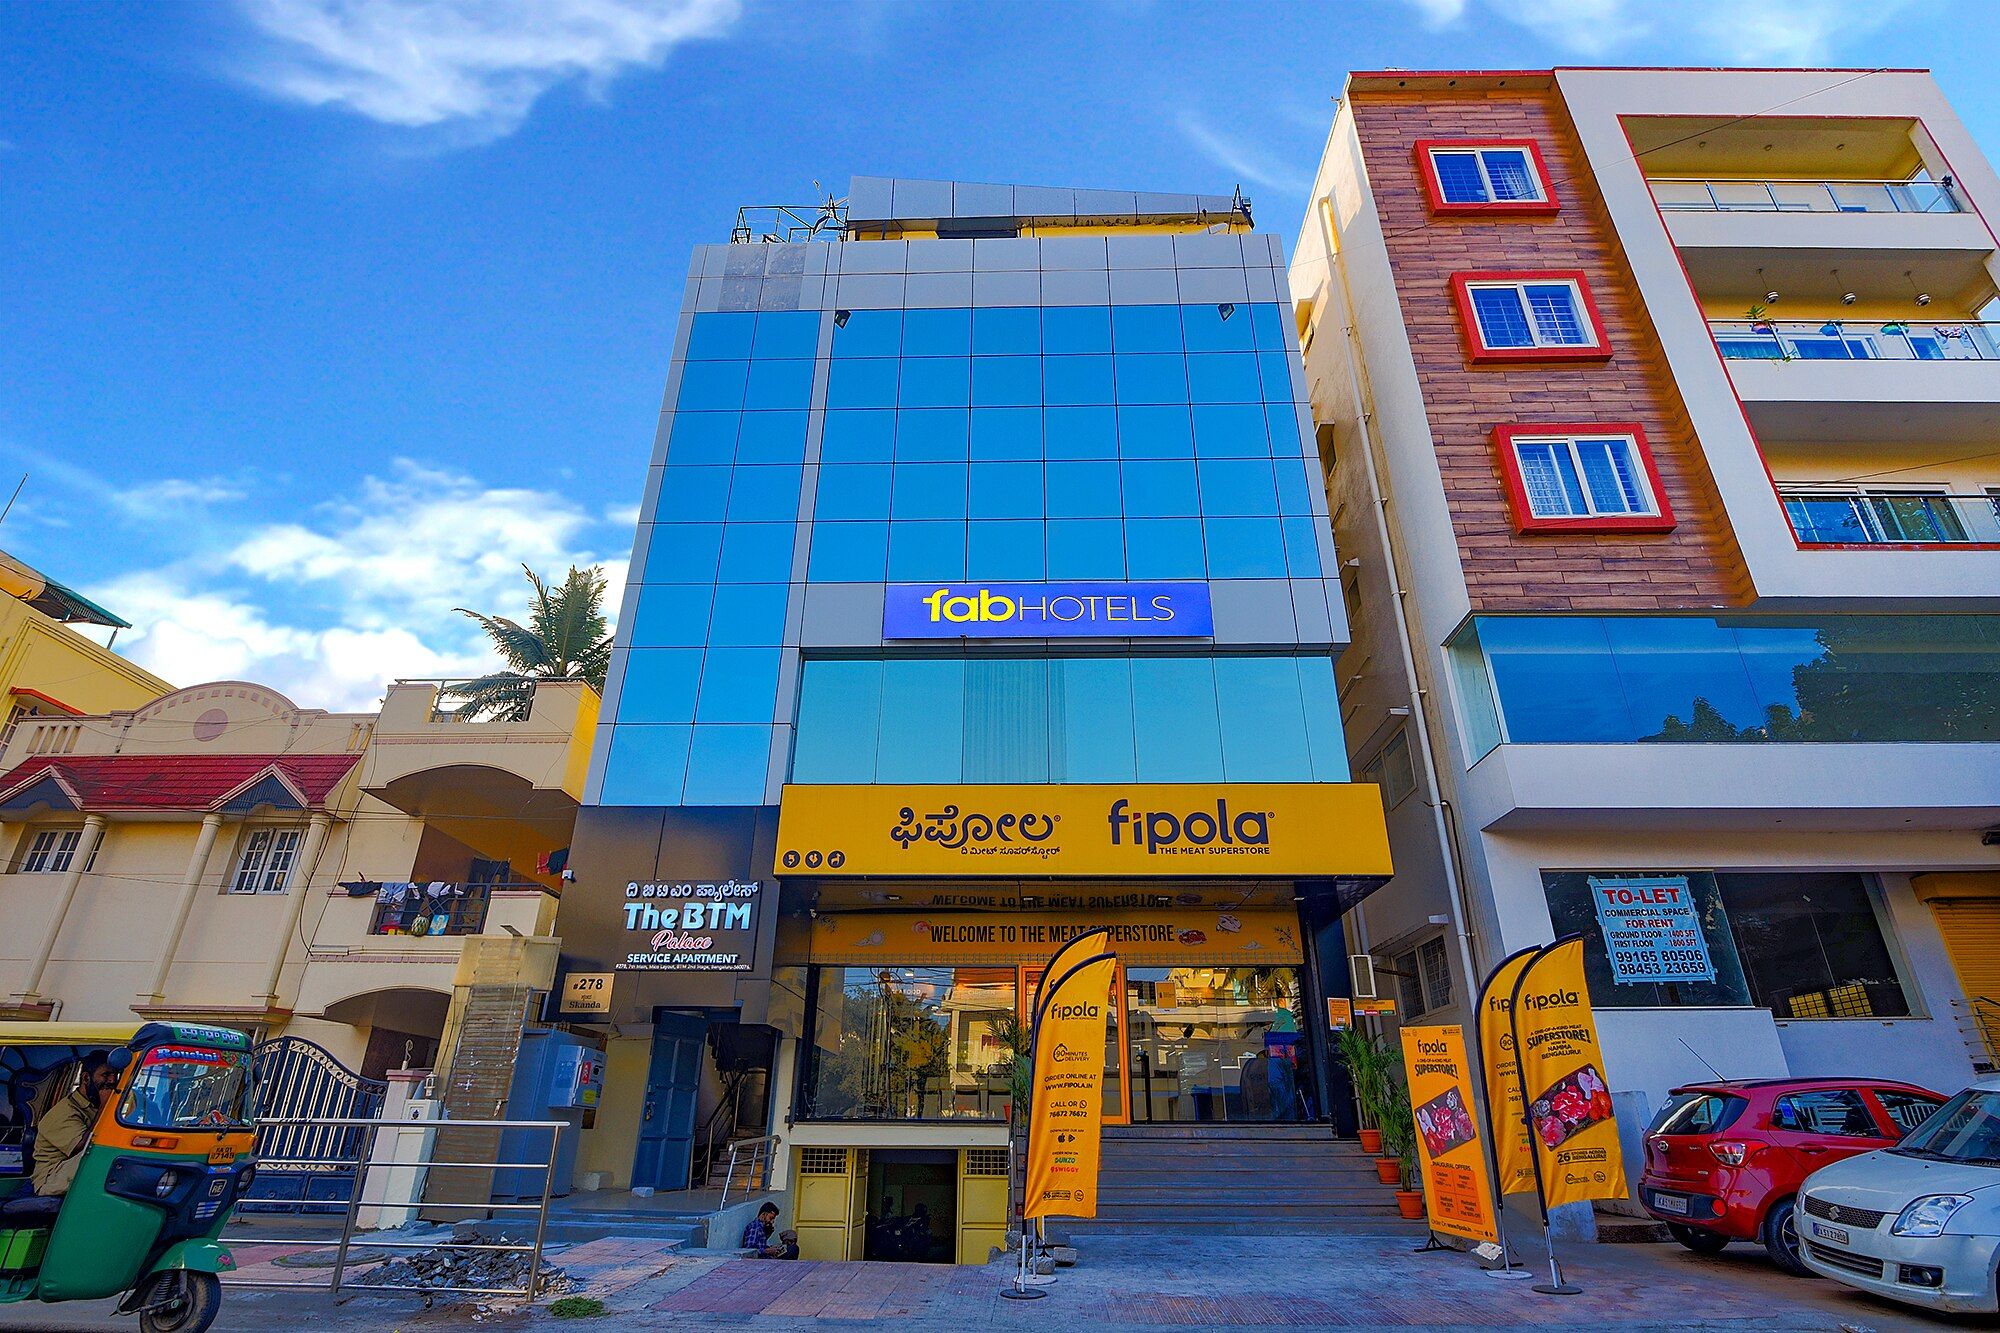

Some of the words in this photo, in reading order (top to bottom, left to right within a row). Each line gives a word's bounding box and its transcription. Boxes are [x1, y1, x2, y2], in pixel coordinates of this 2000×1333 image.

[1108, 799, 1269, 854] fipola
[1603, 888, 1680, 904] TO-LET
[623, 902, 679, 929] The
[681, 902, 752, 929] BTM
[1605, 908, 1661, 917] COMMERCIAL
[1663, 907, 1690, 916] SPACE
[1626, 919, 1646, 928] FOR
[1648, 919, 1674, 928] RENT
[931, 925, 996, 943] WELCOME
[999, 925, 1016, 943] TO
[1020, 925, 1045, 943] THE
[1090, 924, 1174, 942] PERSTORE
[1610, 931, 1639, 939] GROUND
[1641, 930, 1662, 938] FLOOR
[1685, 929, 1696, 937] SFT
[650, 929, 713, 952] Palace
[1614, 940, 1630, 948] FIRST
[1633, 940, 1654, 948] FLOOR
[627, 953, 671, 963] SERVICE
[673, 953, 738, 964] APARTMENT
[1616, 951, 1658, 962] 99165
[1661, 950, 1703, 961] 80506
[1618, 963, 1661, 974] 98453
[1664, 962, 1707, 974] 23659
[573, 979, 604, 990] #278
[569, 1001, 601, 1009] Skanda
[1524, 989, 1579, 1010] fipola
[1051, 1001, 1098, 1020] fipola
[1526, 1029, 1591, 1050] SUPERSTORE!
[1417, 1039, 1447, 1055] fipola
[1548, 1044, 1572, 1052] NAMMA
[157, 1048, 218, 1062] Roushni
[1541, 1049, 1582, 1060] BENGALURU!
[1044, 1074, 1065, 1082] ORDER
[1415, 1064, 1459, 1080] SUPERSTORE!
[1045, 1082, 1093, 1091] WWW.FIPOLA.IN
[1050, 1100, 1066, 1109] CALL
[1557, 1152, 1571, 1164] 26
